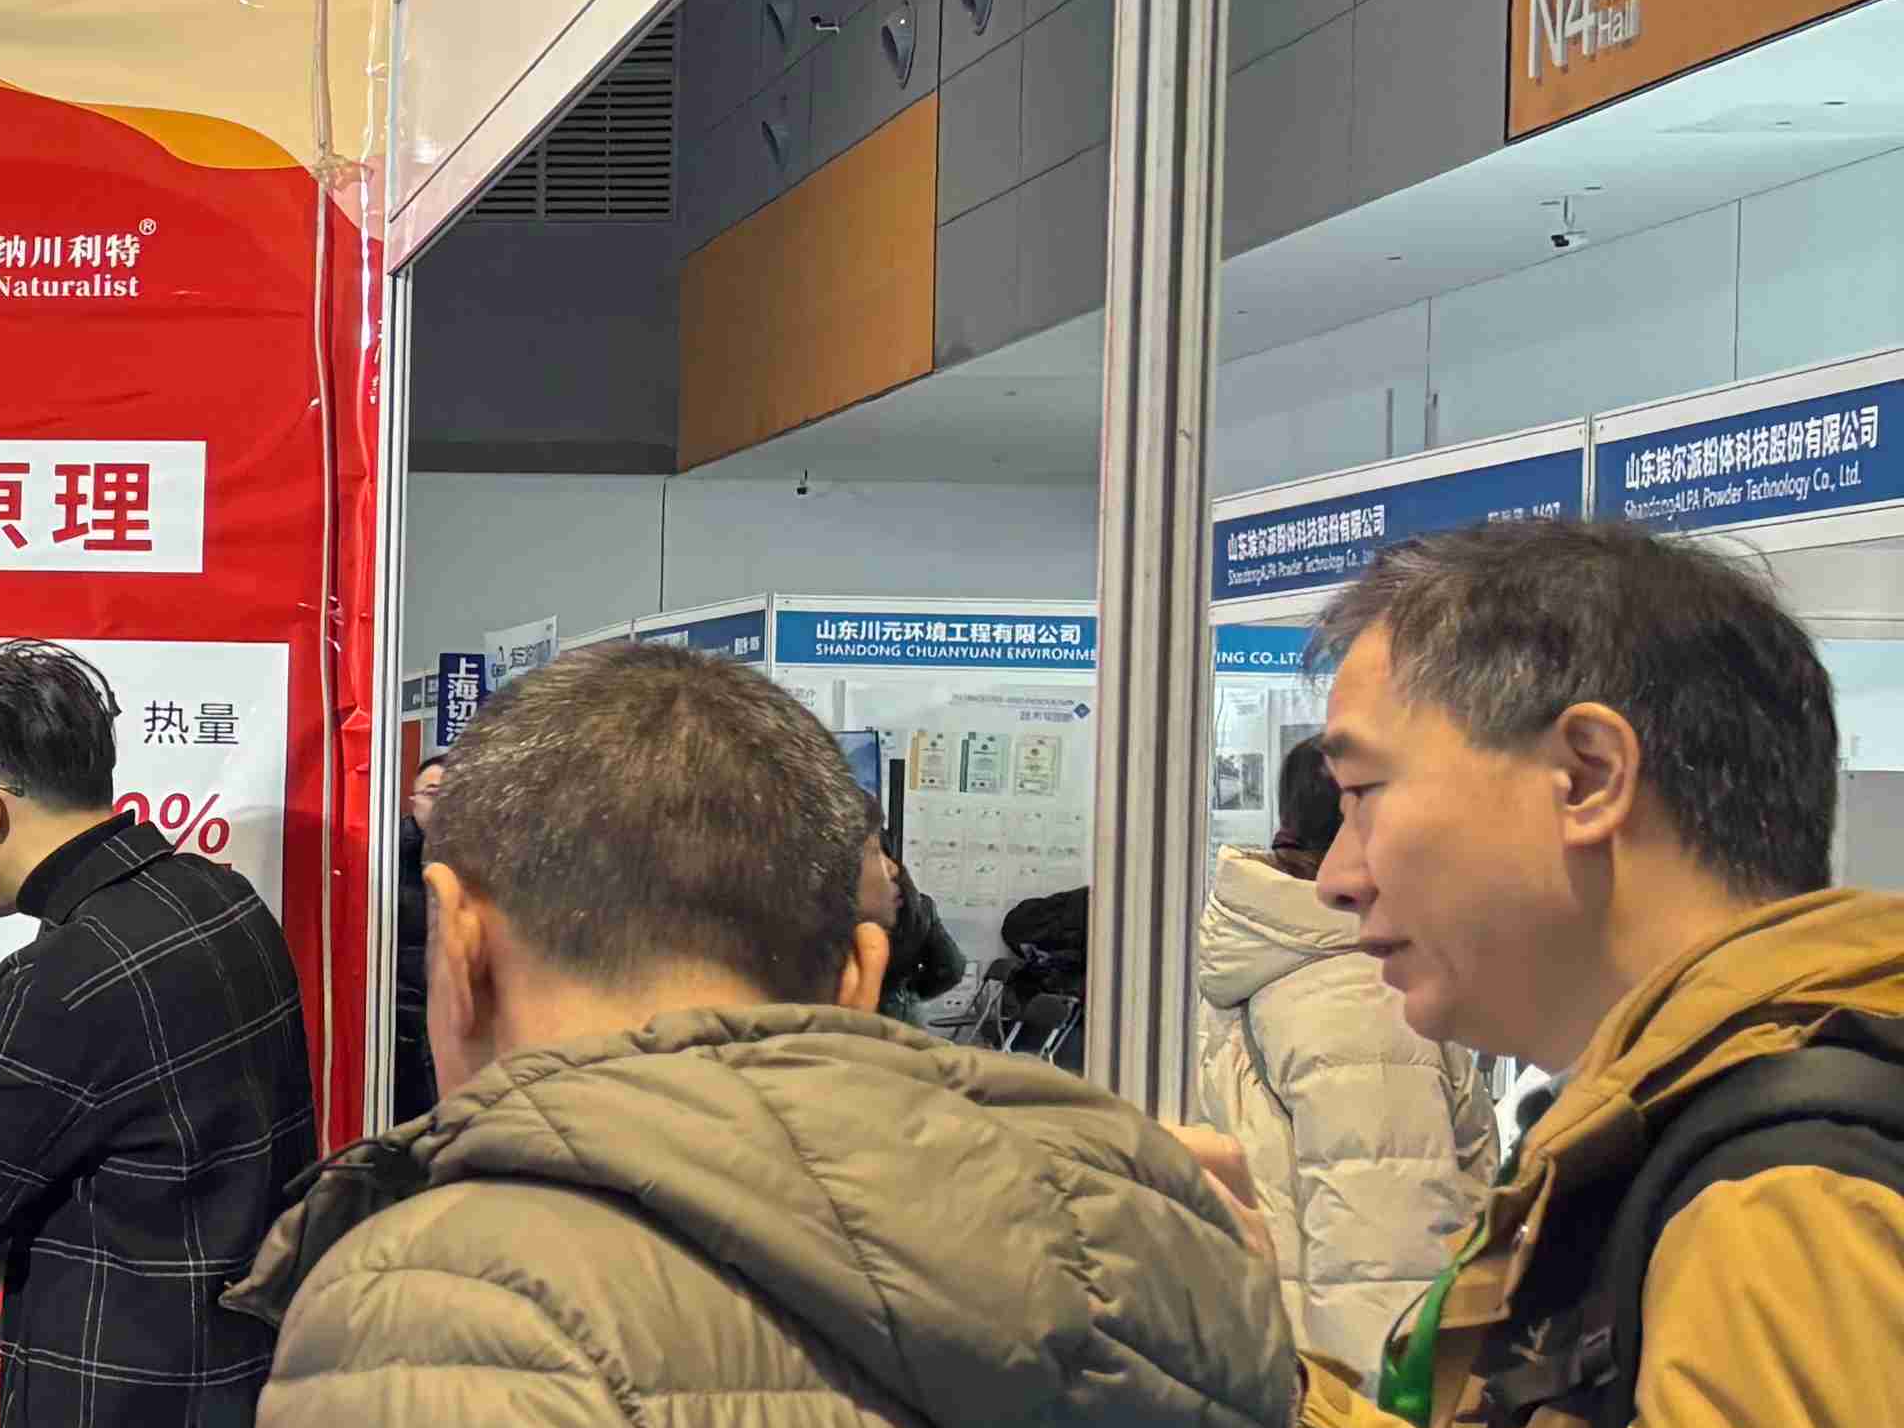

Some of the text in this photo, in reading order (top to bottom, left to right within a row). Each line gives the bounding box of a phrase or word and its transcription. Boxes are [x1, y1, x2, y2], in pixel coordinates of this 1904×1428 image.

[1625, 405, 1879, 490] 山东埃尔派粉体科技股份有限公司
[1703, 480, 1743, 509] Powder
[1746, 473, 1810, 501] Technology
[1840, 460, 1861, 487] Ltd.
[815, 644, 901, 657] SHANDONG
[906, 645, 1001, 660] CHUANYUAN
[143, 700, 240, 746] 热量
